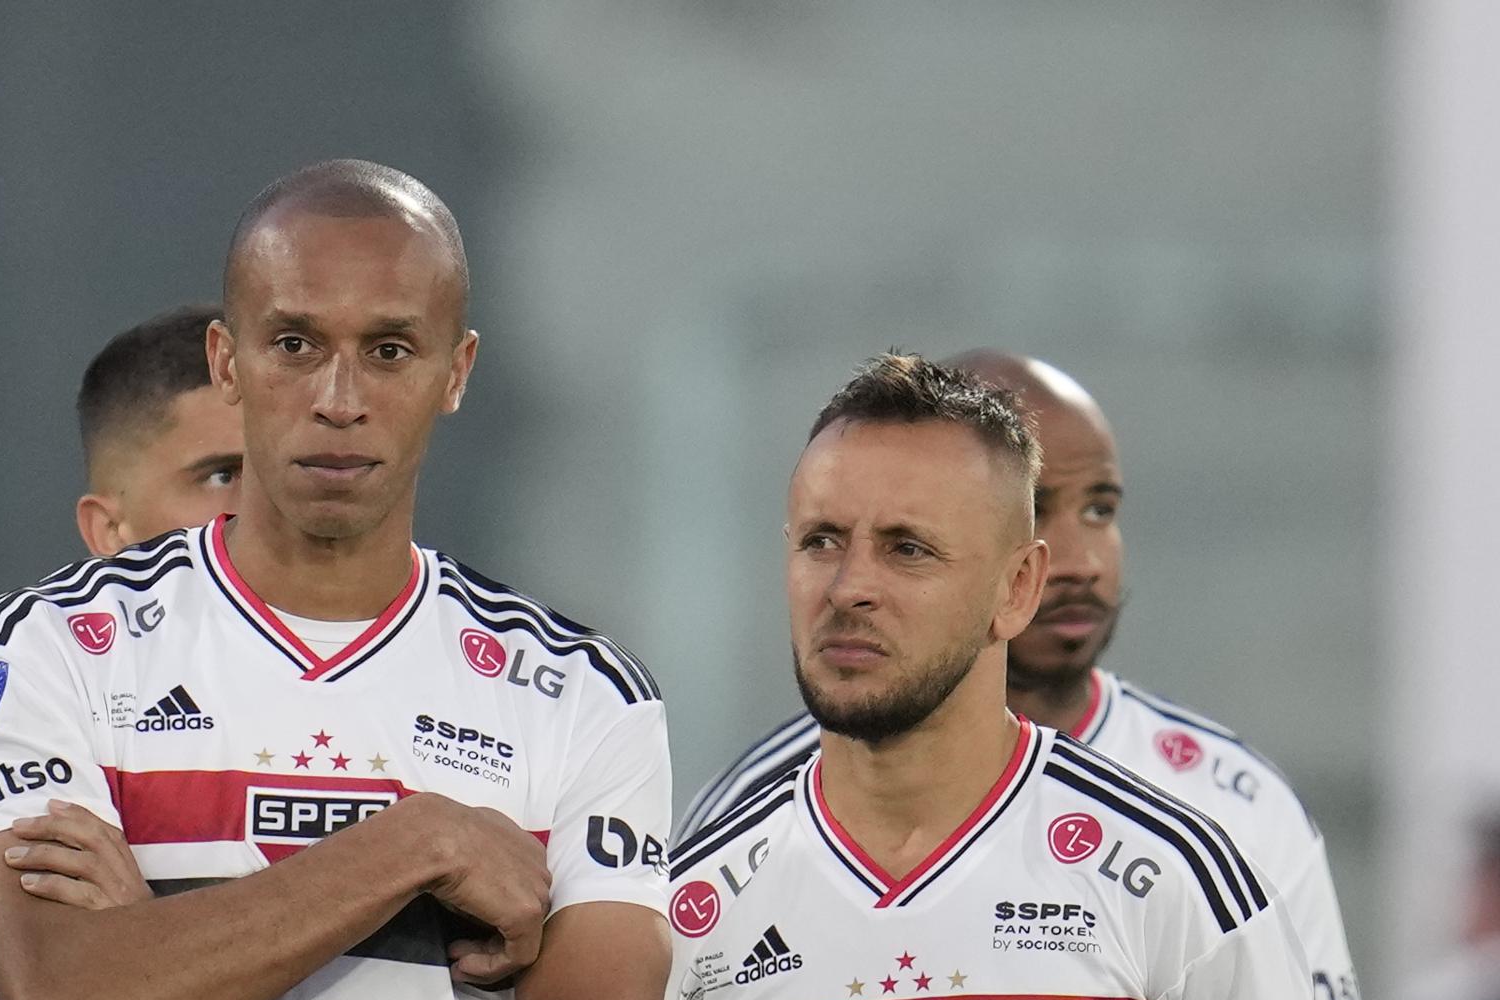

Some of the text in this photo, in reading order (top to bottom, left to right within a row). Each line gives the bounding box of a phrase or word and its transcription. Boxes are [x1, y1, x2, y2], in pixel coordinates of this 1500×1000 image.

[119, 599, 166, 638] LG
[507, 649, 567, 699] LG
[135, 714, 214, 732] adidas
[412, 747, 430, 762] by
[413, 735, 512, 773] FAN TOKEN
[719, 837, 770, 897] LG
[1097, 839, 1162, 899] LG
[992, 937, 1012, 952] by
[994, 924, 1031, 935] FAN
[734, 953, 804, 985] adidas
